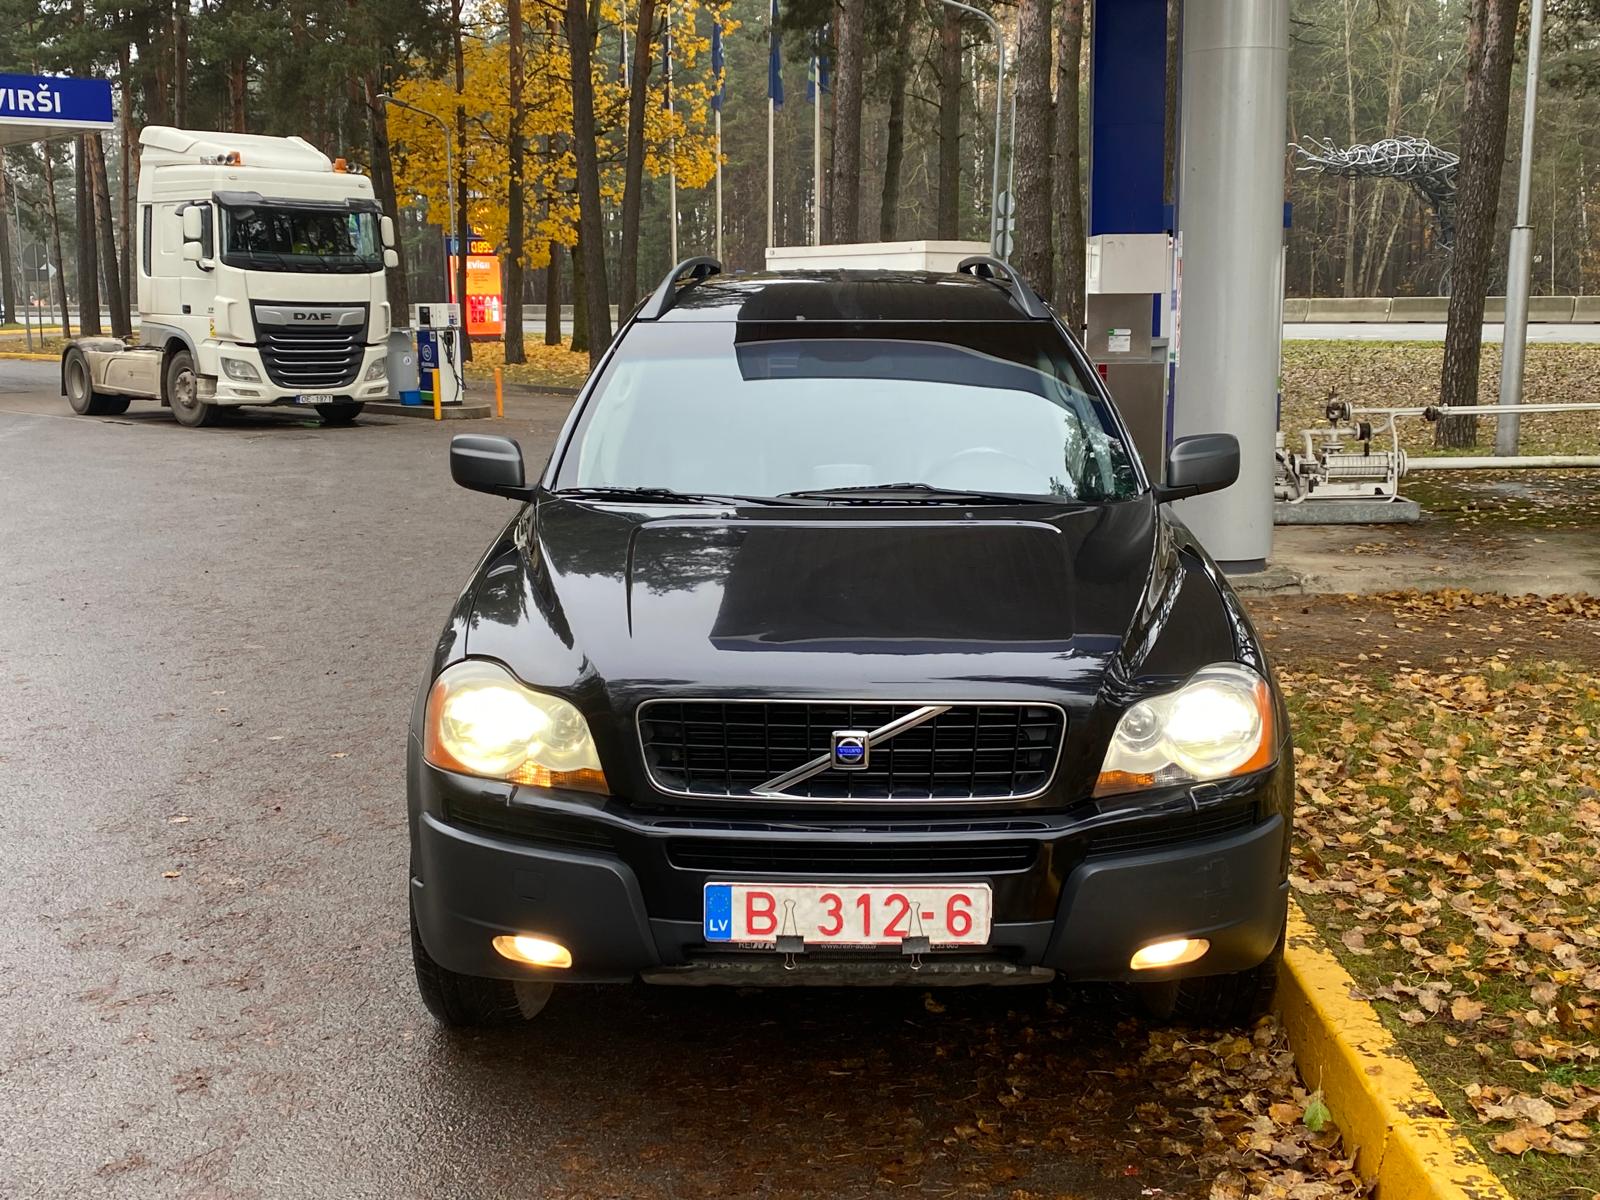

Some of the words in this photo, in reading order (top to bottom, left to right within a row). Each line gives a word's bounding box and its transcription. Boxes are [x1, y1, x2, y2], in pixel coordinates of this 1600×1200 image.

[293, 312, 332, 321] DAF
[745, 891, 778, 935] B
[709, 919, 728, 932] LV
